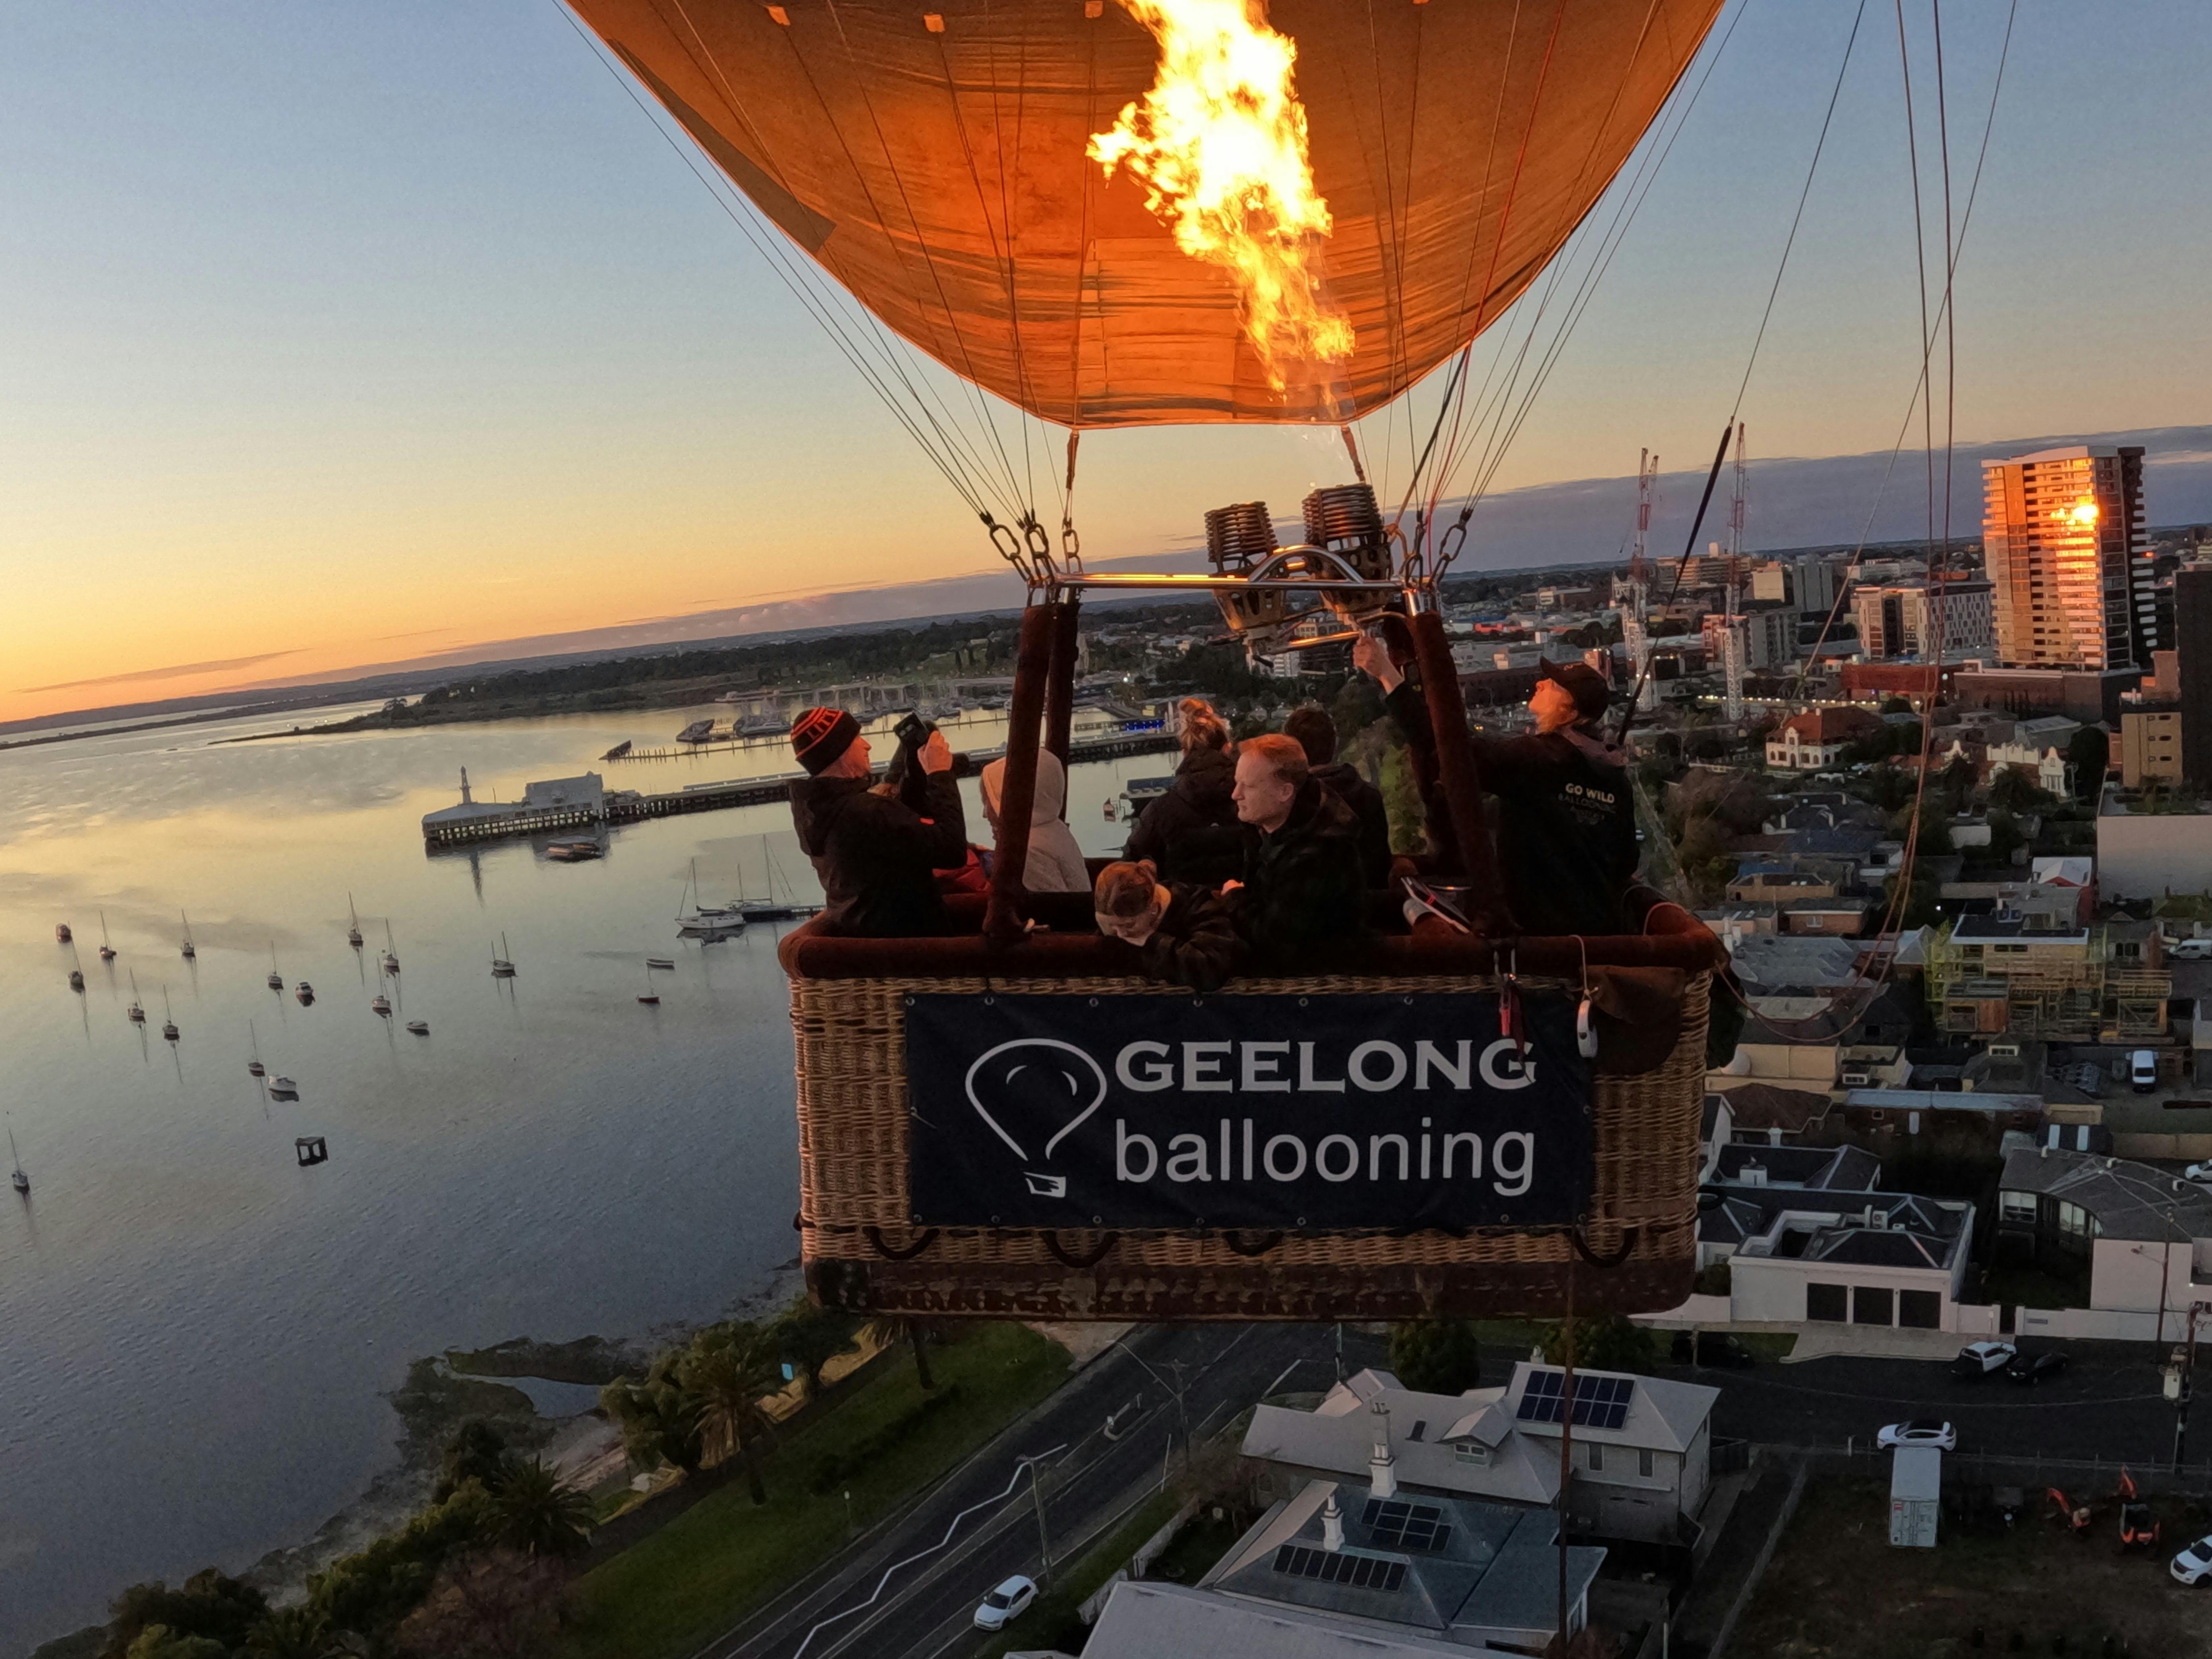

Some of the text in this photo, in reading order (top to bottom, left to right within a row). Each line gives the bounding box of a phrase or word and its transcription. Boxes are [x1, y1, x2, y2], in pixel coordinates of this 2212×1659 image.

[1565, 783, 1615, 804] GO WILD
[1116, 1039, 1536, 1093] GEELONG
[1116, 1117, 1534, 1197] ballooning
